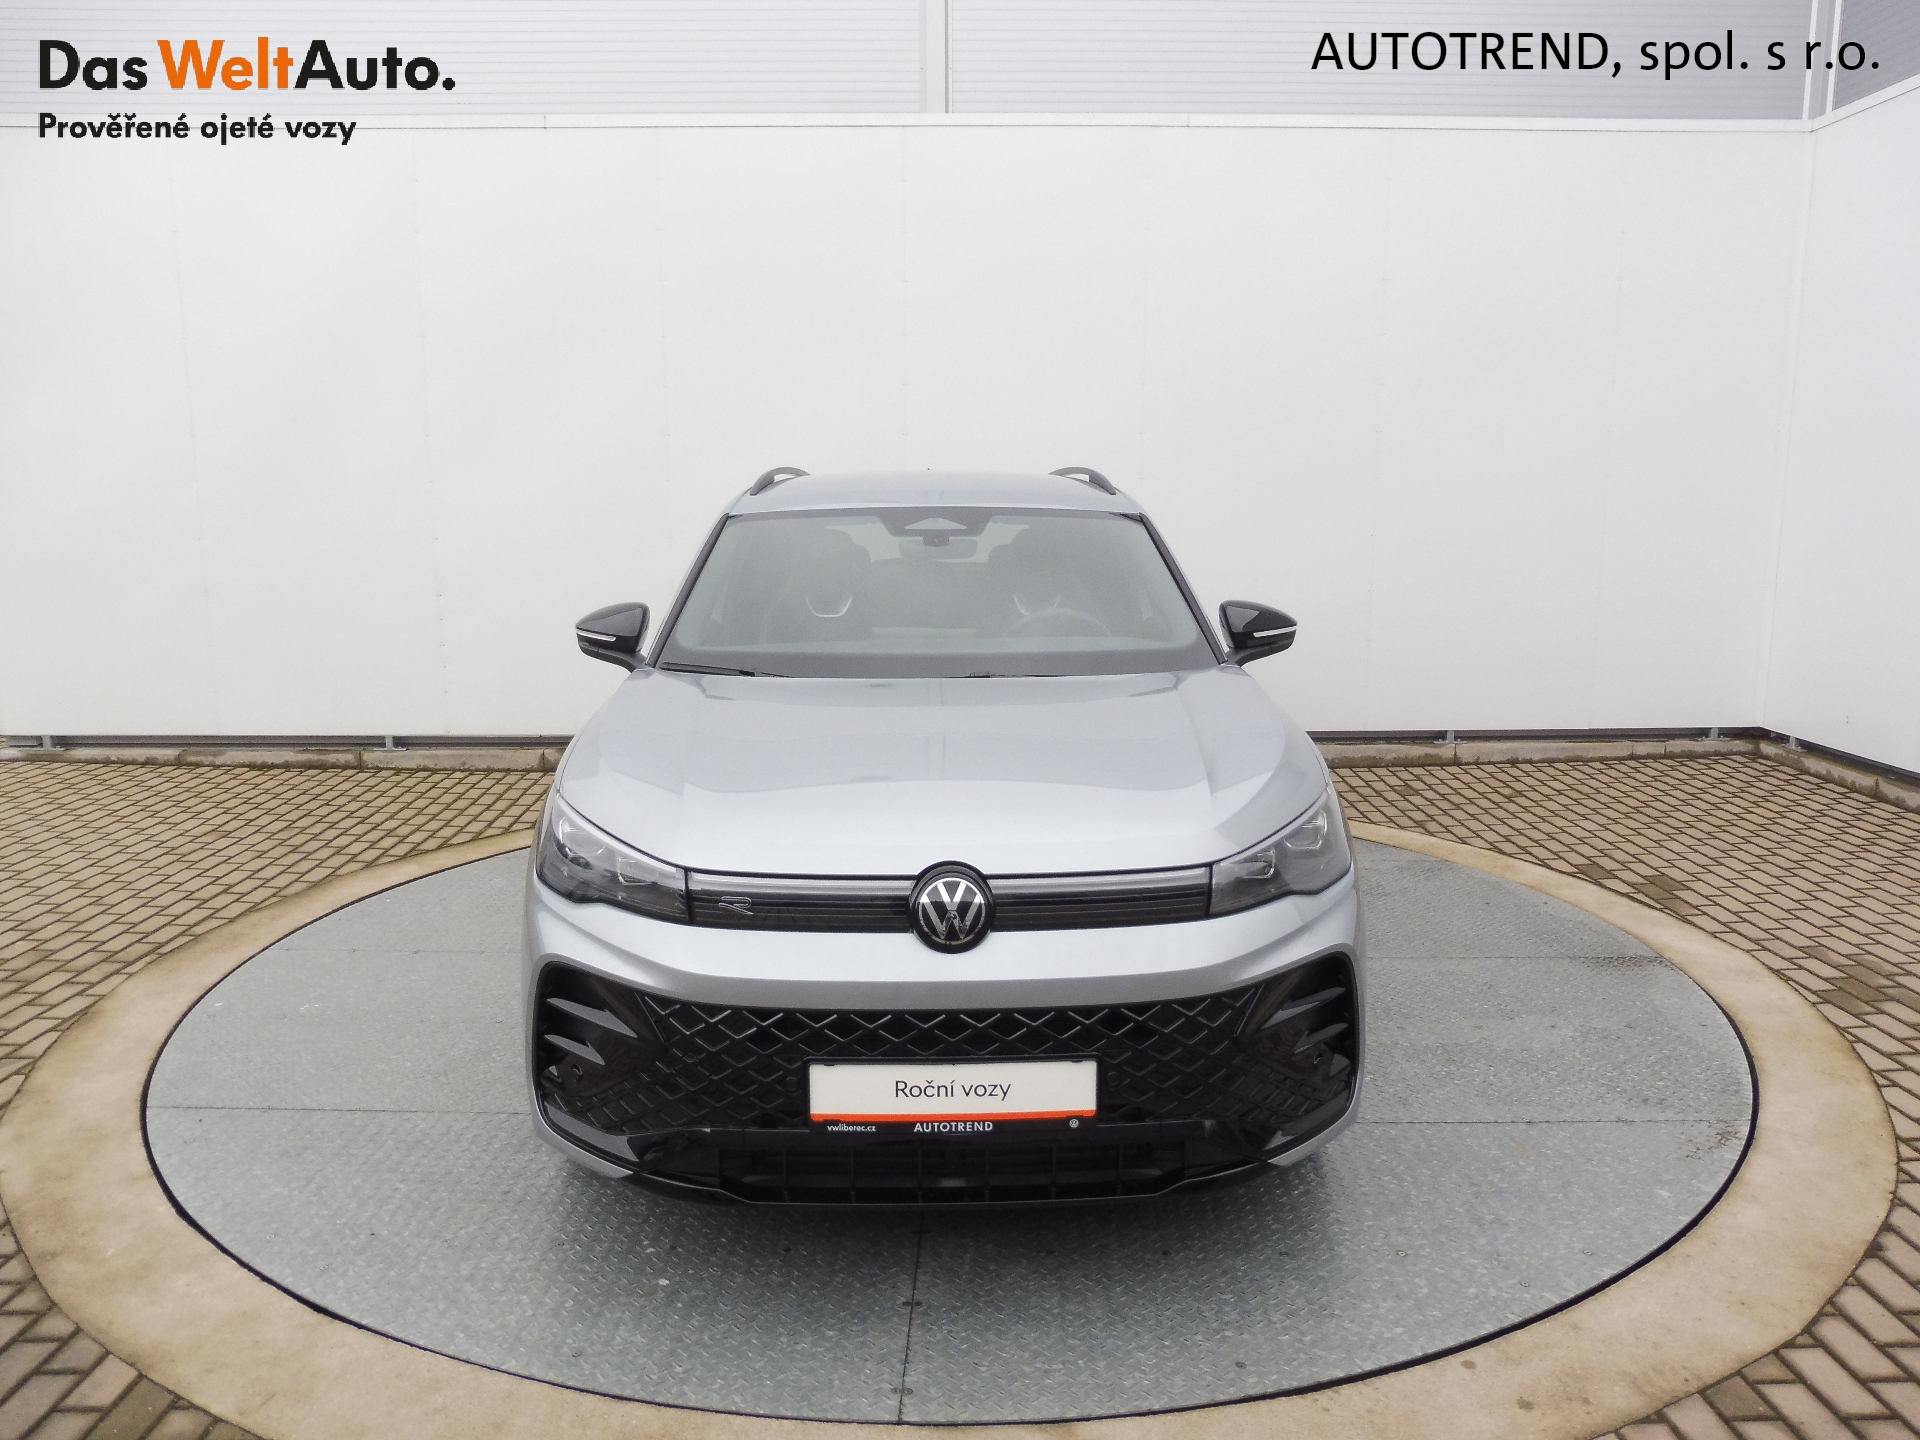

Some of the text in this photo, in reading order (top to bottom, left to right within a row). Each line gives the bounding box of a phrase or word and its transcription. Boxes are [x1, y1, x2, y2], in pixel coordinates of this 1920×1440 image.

[894, 1080, 1011, 1101] Roční vozy
[827, 1123, 876, 1133] vwliberec.cz
[913, 1121, 993, 1133] AUTOTREND
